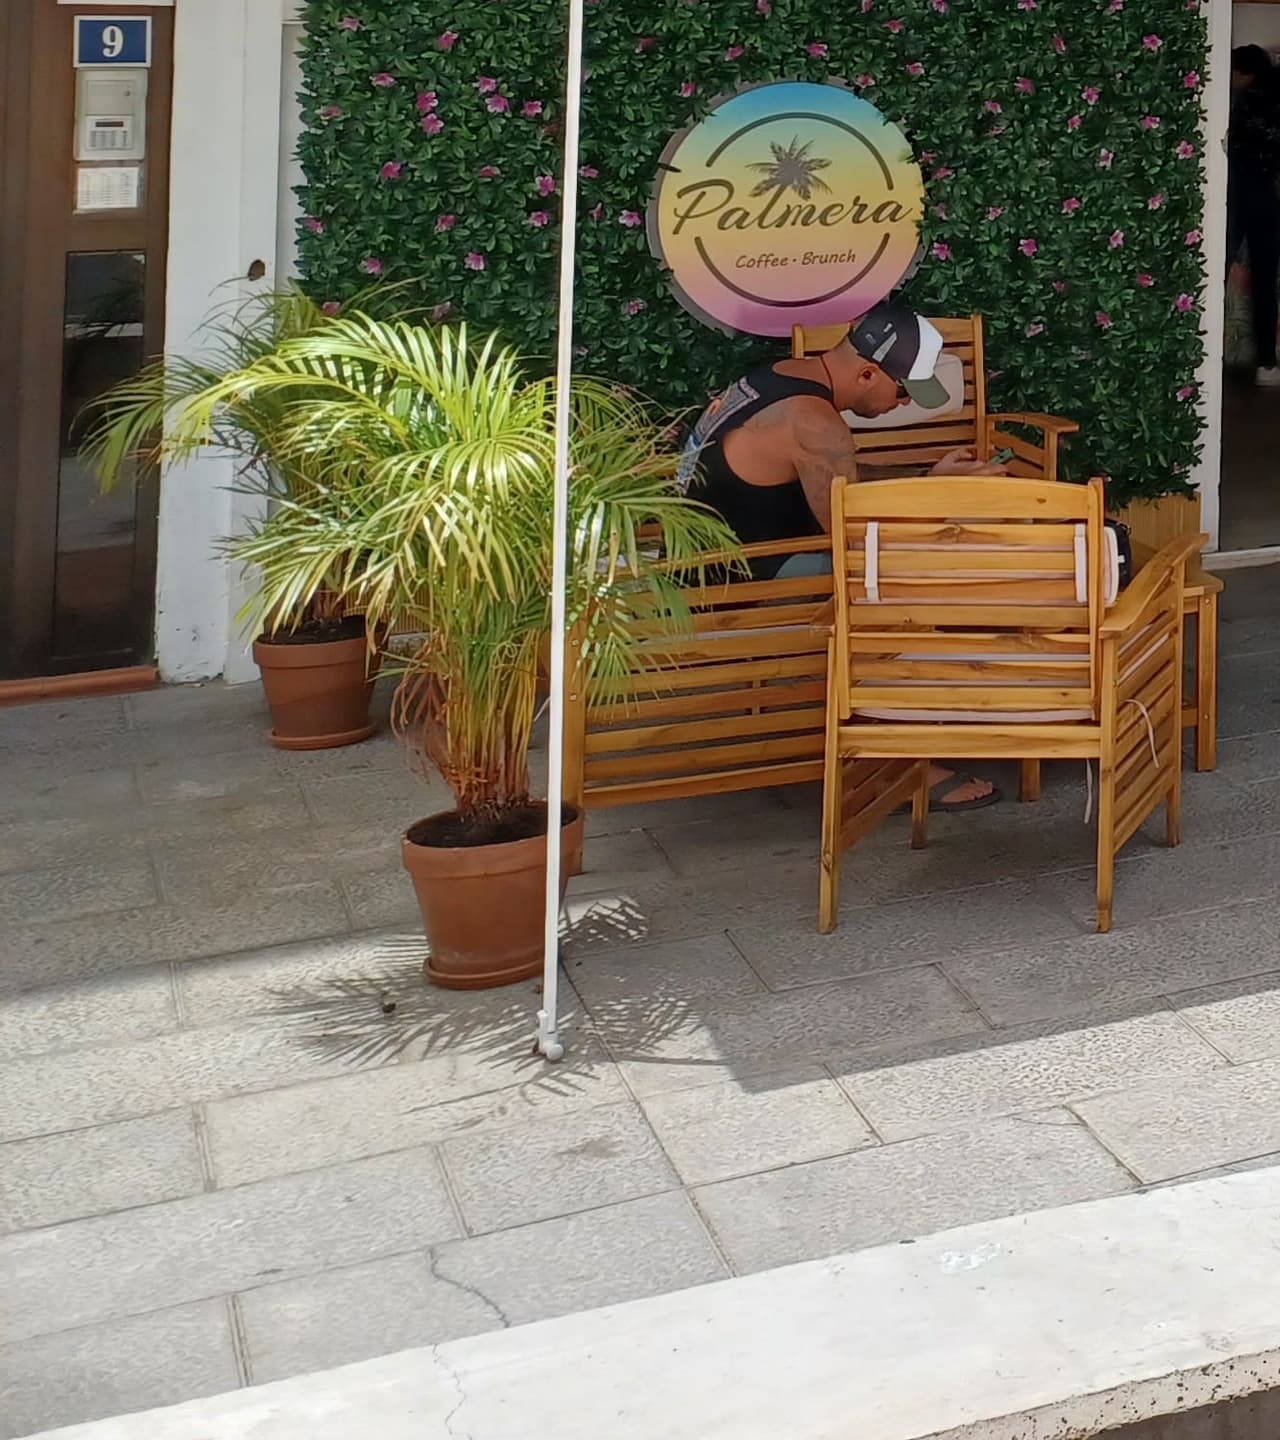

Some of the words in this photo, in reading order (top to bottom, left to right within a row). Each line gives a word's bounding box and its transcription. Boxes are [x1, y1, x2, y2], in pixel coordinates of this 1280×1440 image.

[102, 25, 124, 58] 9
[672, 178, 914, 235] Palmera
[735, 252, 789, 269] Coffee
[801, 248, 857, 266] Brunch
